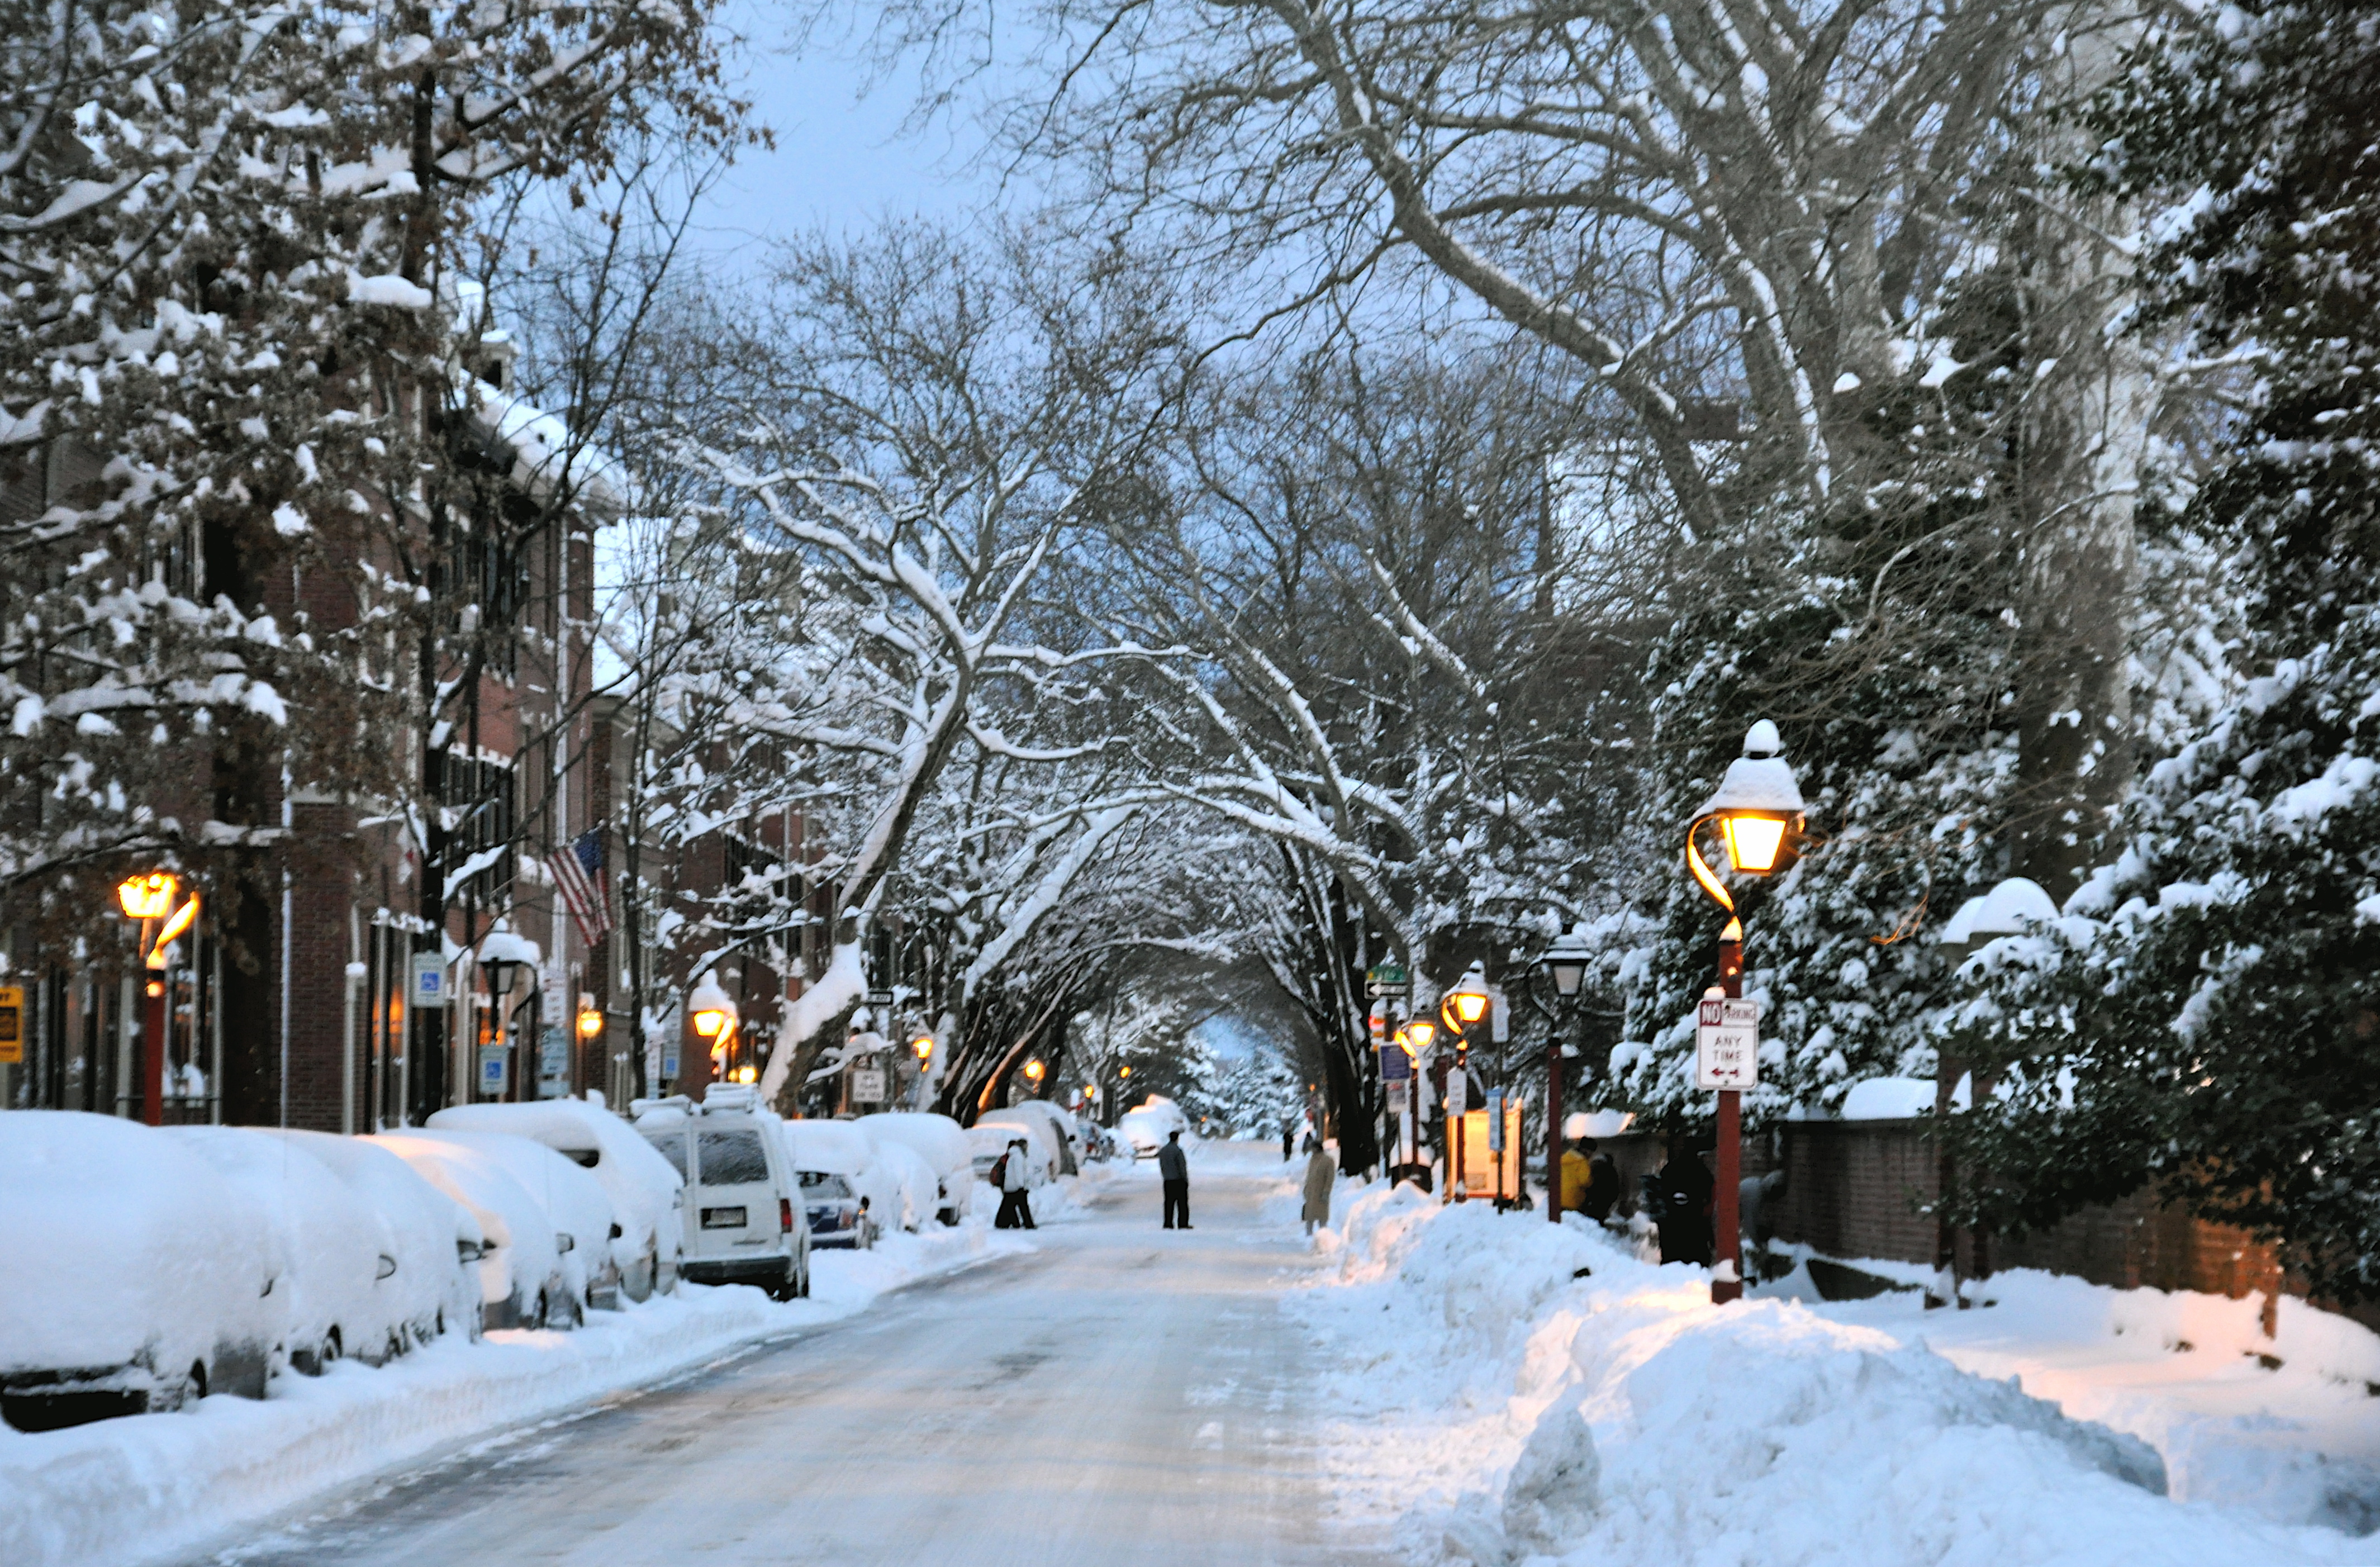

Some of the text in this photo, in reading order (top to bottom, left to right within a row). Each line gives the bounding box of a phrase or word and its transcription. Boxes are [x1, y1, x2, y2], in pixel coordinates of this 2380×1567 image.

[1702, 1004, 1755, 1024] NO PARKING
[1714, 1036, 1742, 1047] ANY
[1713, 1050, 1742, 1061] TIME
